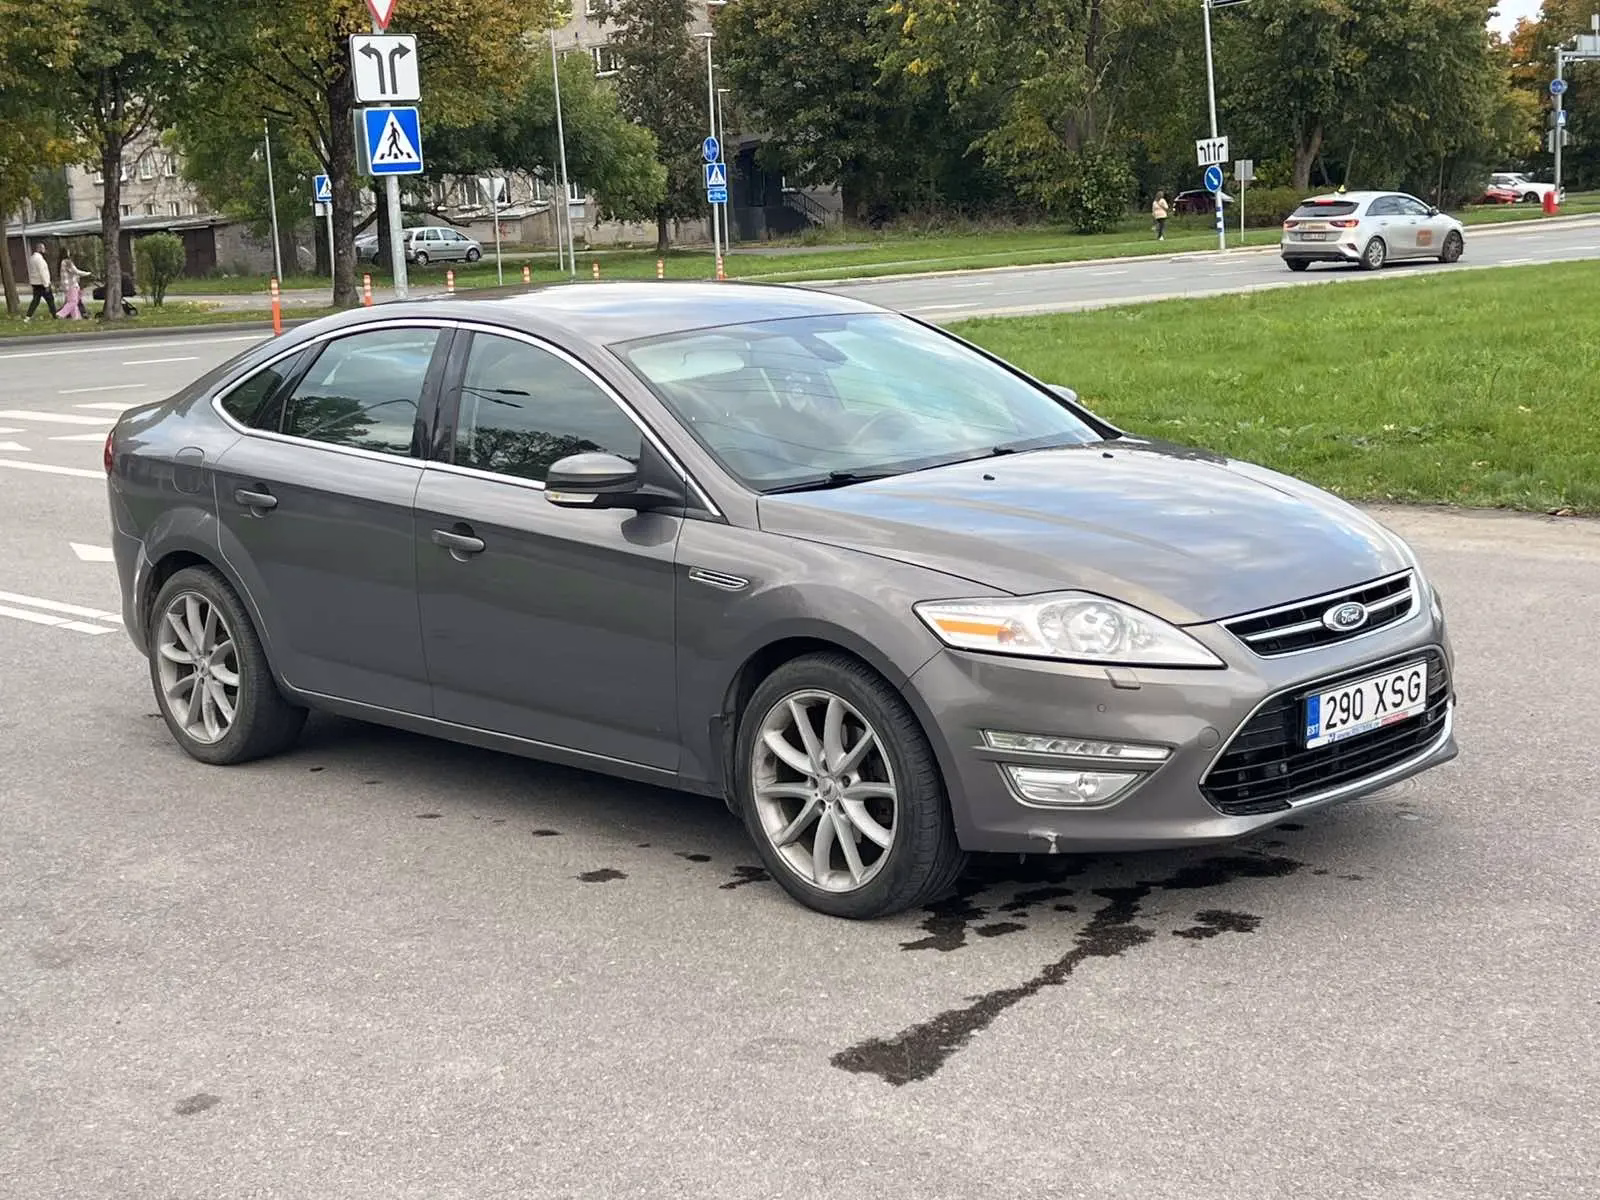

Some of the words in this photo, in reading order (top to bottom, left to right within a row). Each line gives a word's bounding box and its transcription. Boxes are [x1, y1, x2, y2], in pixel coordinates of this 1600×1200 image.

[1341, 608, 1360, 624] Ford
[1325, 688, 1363, 730] 290
[1374, 671, 1421, 715] XSG
